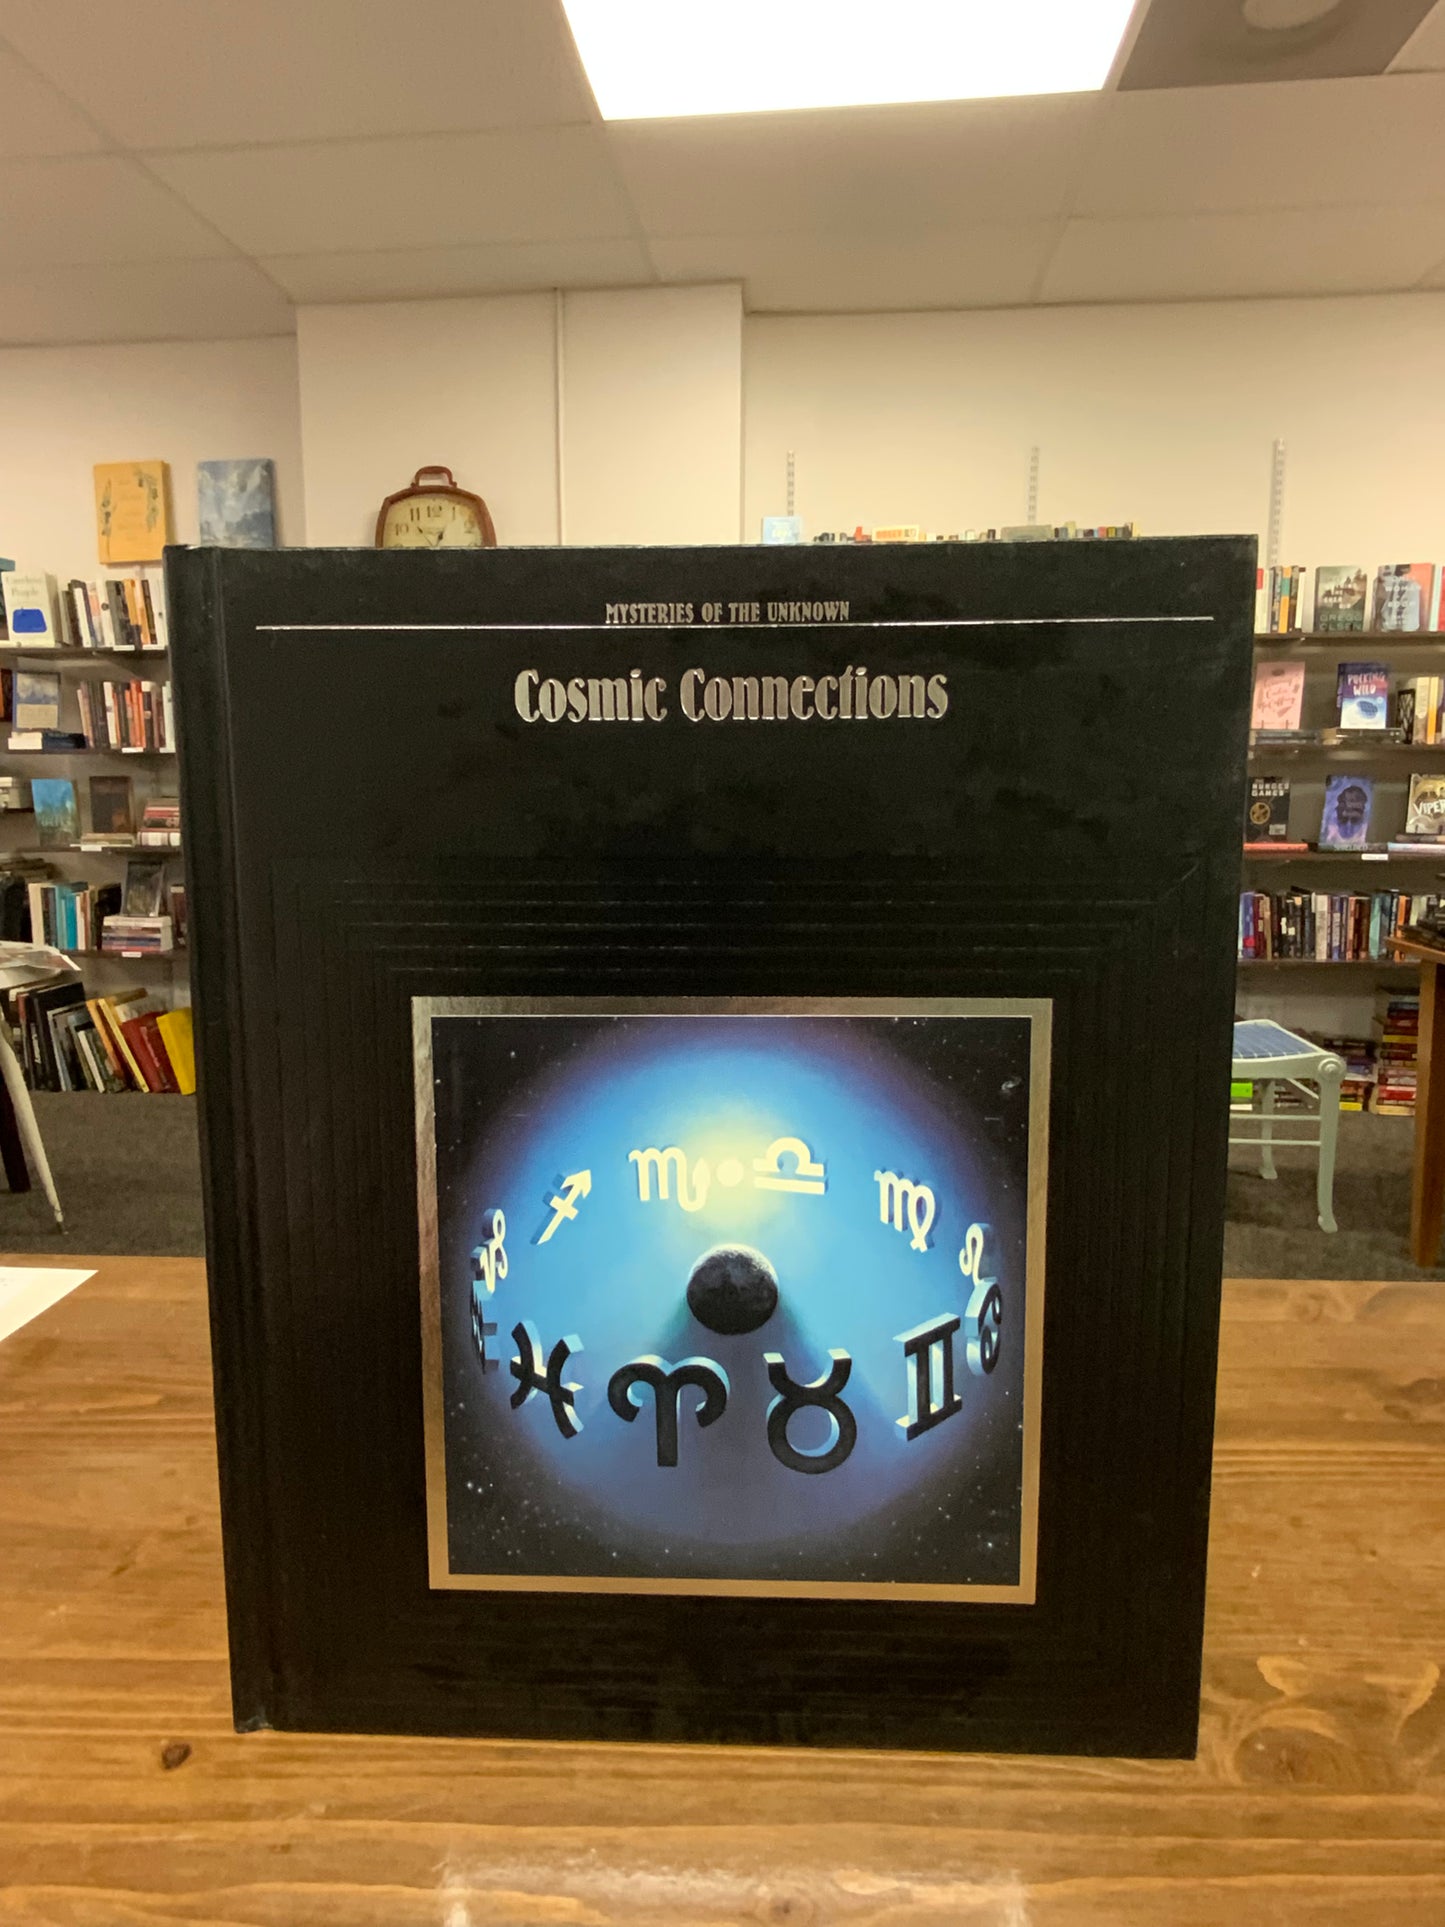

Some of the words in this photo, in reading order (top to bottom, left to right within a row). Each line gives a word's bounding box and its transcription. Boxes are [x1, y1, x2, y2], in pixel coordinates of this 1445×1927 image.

[605, 603, 694, 624] MYSTERIES
[701, 602, 723, 623] OF
[728, 602, 760, 623] THE
[767, 601, 850, 622] UNKNOWN
[514, 668, 667, 722] Cosmic
[679, 665, 949, 722] Connections
[1353, 684, 1377, 696] WILD
